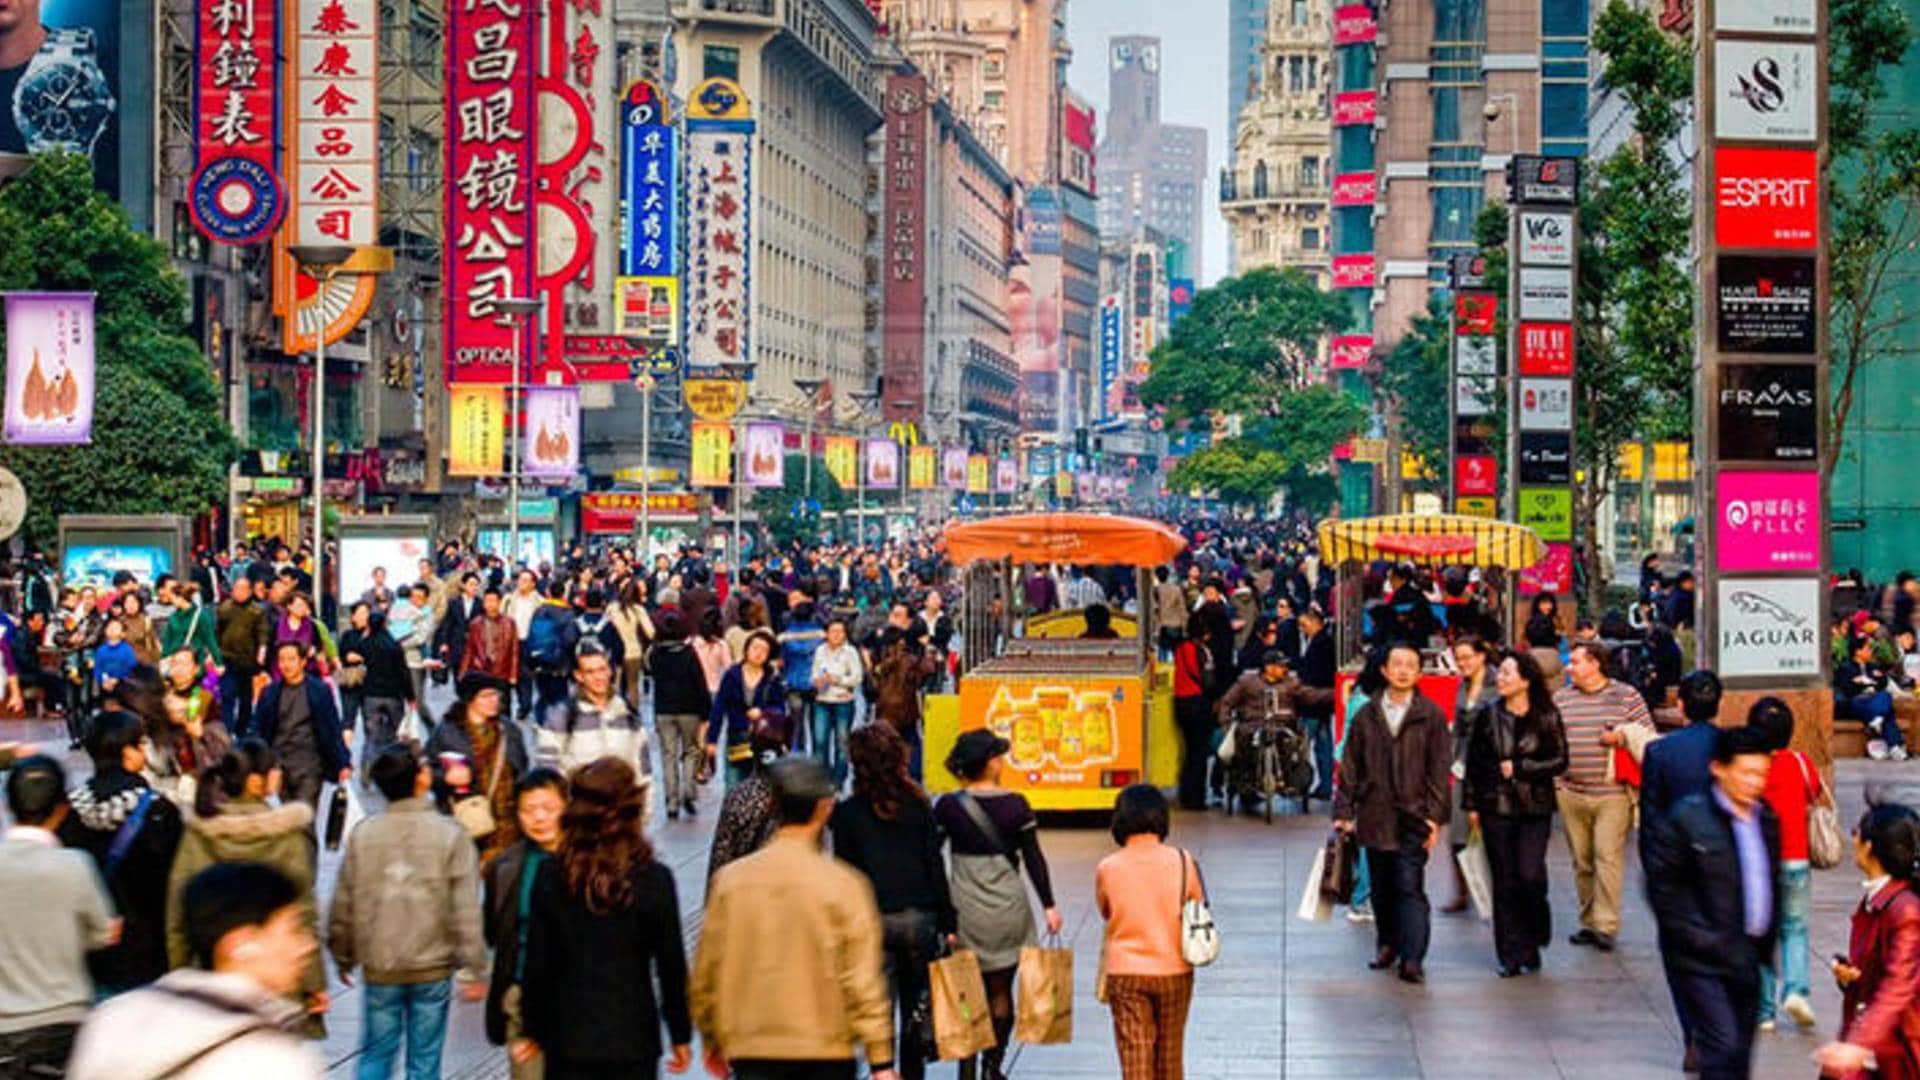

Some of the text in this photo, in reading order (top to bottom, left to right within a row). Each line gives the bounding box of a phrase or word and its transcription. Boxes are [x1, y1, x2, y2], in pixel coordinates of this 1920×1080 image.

[1720, 177, 1811, 208] ESPRIT
[456, 345, 518, 366] OPTICA
[1721, 389, 1812, 406] FRAAS
[1724, 628, 1815, 649] JAGUAR
